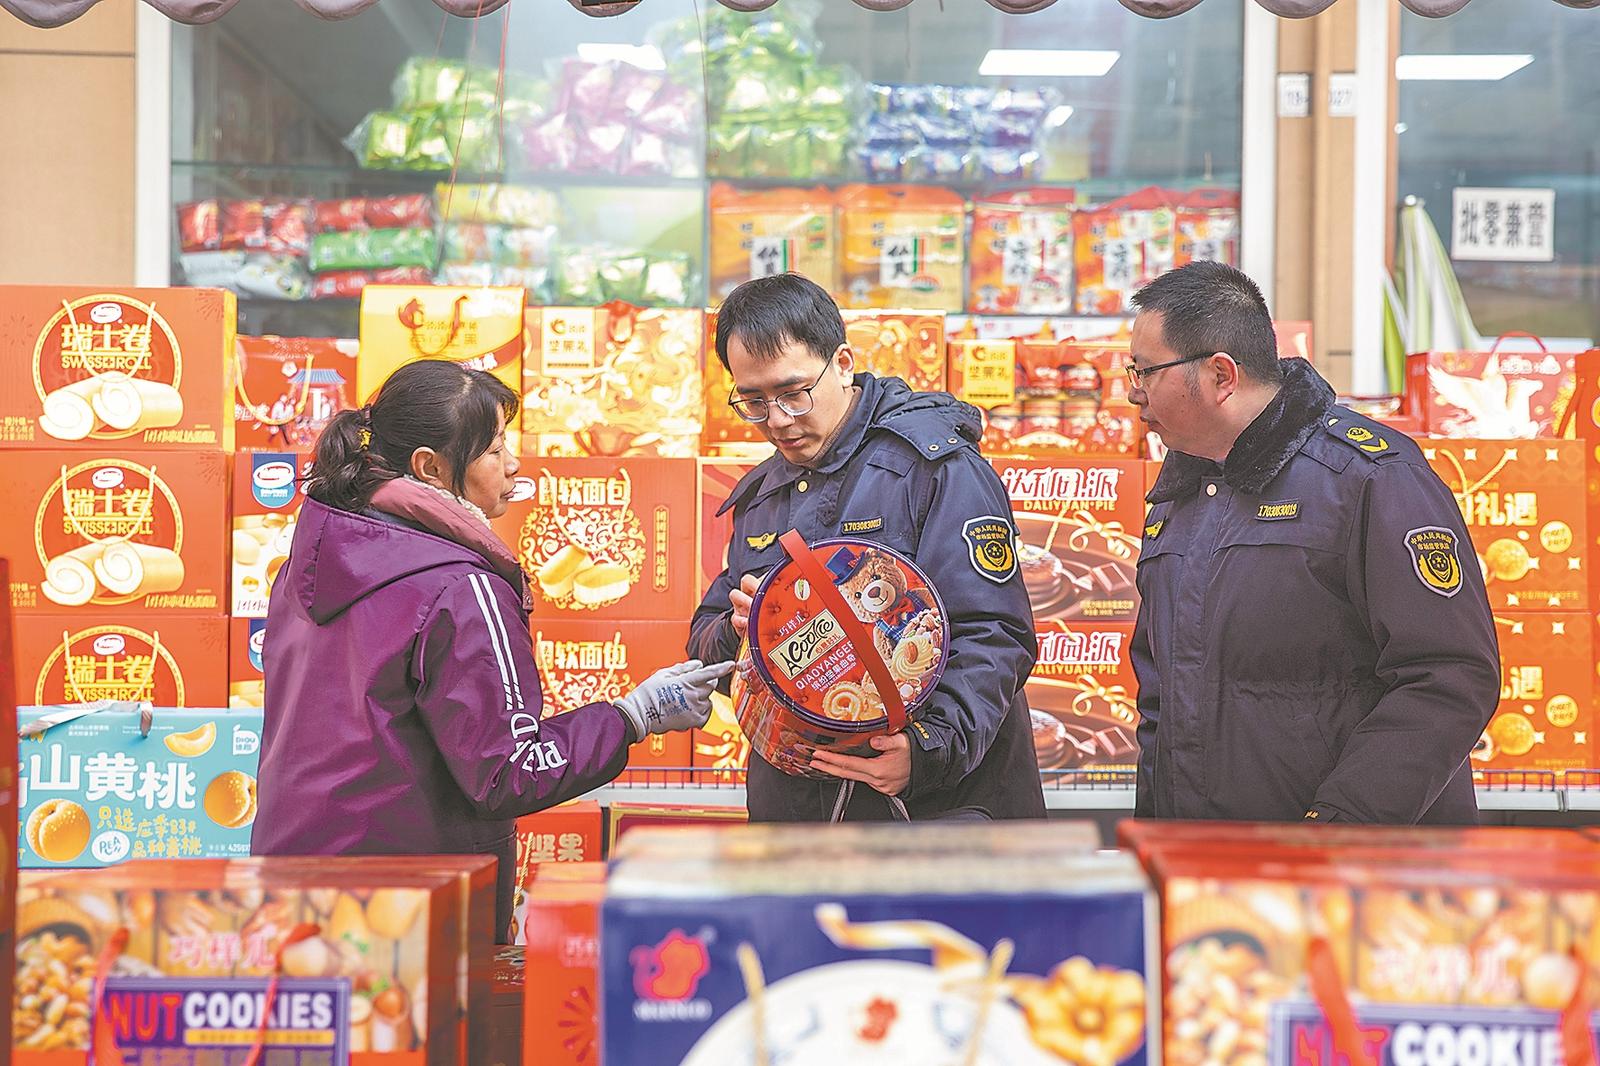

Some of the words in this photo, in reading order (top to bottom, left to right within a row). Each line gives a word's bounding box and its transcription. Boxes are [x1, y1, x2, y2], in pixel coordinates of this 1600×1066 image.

[61, 322, 152, 351] 瑞士卷
[61, 355, 104, 369] SWISS
[115, 355, 152, 369] ROLL
[63, 489, 153, 516] 瑞士卷
[1096, 501, 1115, 510] PIE
[63, 522, 105, 535] SWISS
[117, 522, 153, 535] ROLL
[788, 618, 834, 662] Cookie
[1036, 631, 1121, 664] 利园派
[65, 655, 154, 683] 瑞士卷
[1031, 664, 1092, 675] ALIYUAN
[1099, 664, 1118, 674] PIE
[64, 688, 105, 701] SWISS
[118, 688, 154, 701] ROLL
[109, 994, 183, 1041] NUT
[184, 992, 333, 1029] COOKIES
[1392, 1022, 1562, 1066] COOKIE
